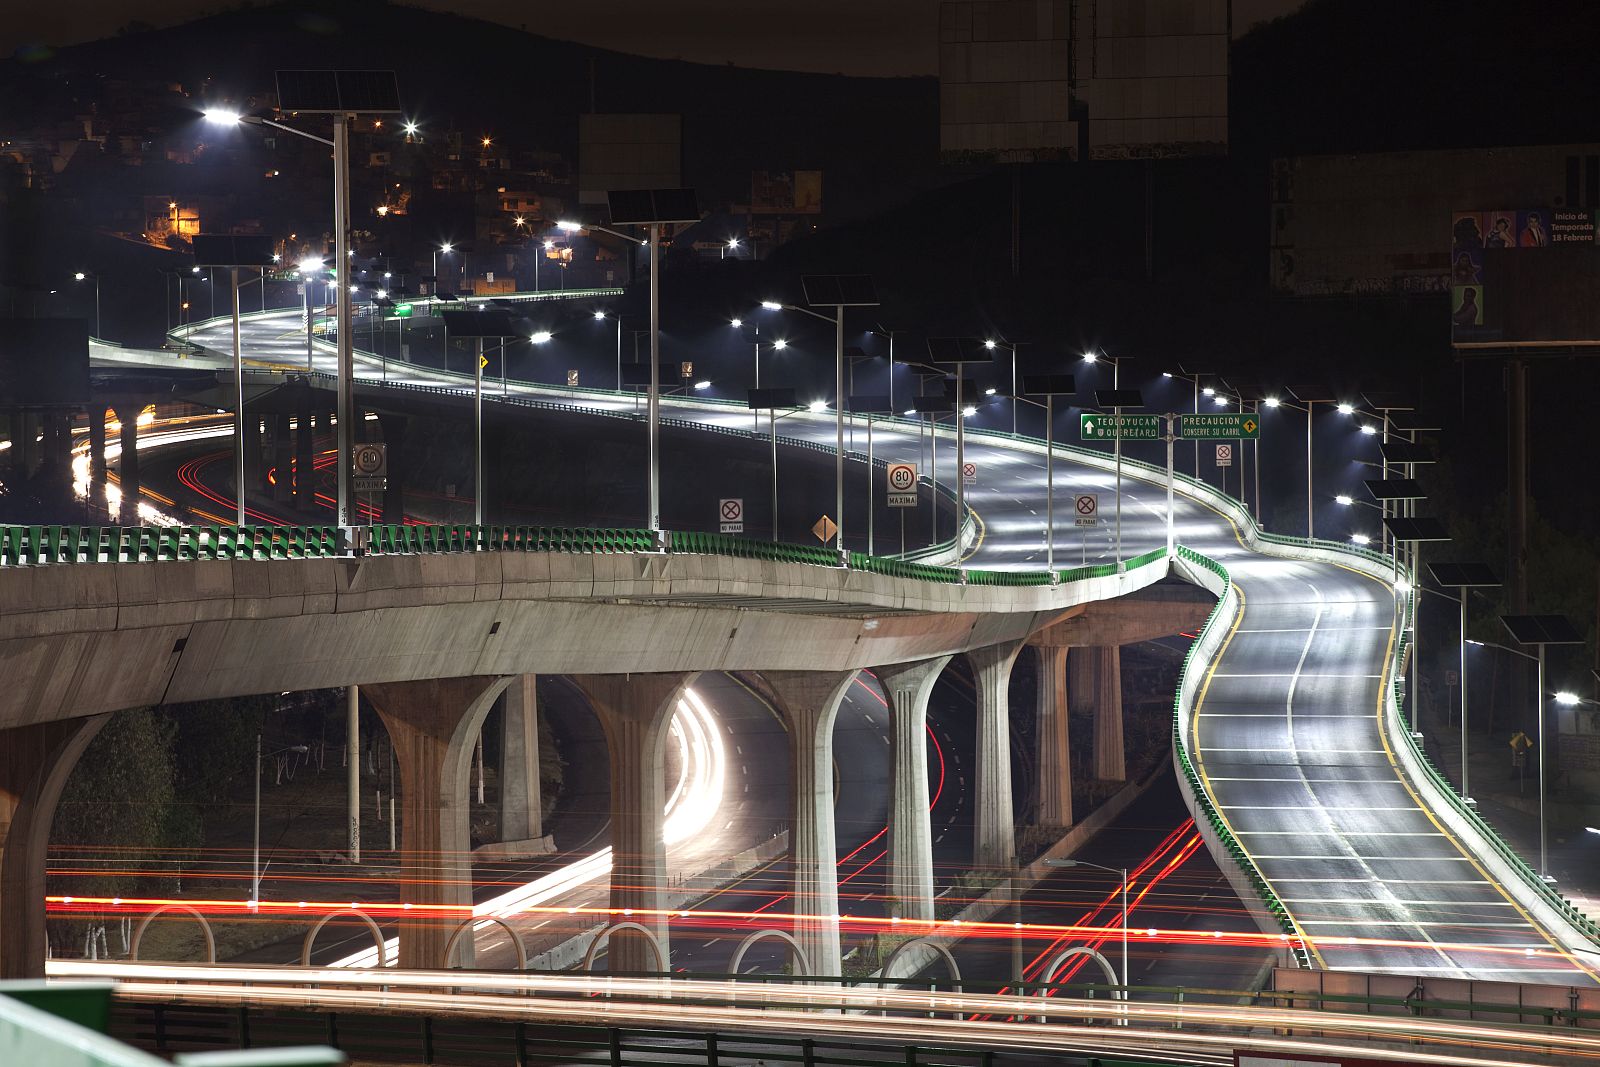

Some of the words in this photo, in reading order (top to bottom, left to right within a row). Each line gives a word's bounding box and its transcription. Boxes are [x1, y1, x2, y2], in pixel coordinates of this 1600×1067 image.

[1555, 213, 1576, 221] Inicio
[1577, 212, 1588, 220] de
[1551, 223, 1594, 232] Temporada
[1552, 234, 1562, 242] 18
[1183, 417, 1240, 425] PRECAUCION
[1183, 428, 1210, 436] CONSERVE
[1212, 428, 1220, 436] SU
[1222, 428, 1240, 436] CARRIL
[362, 451, 377, 464] 80
[895, 471, 909, 482] 80
[889, 497, 915, 505] MAXIMA
